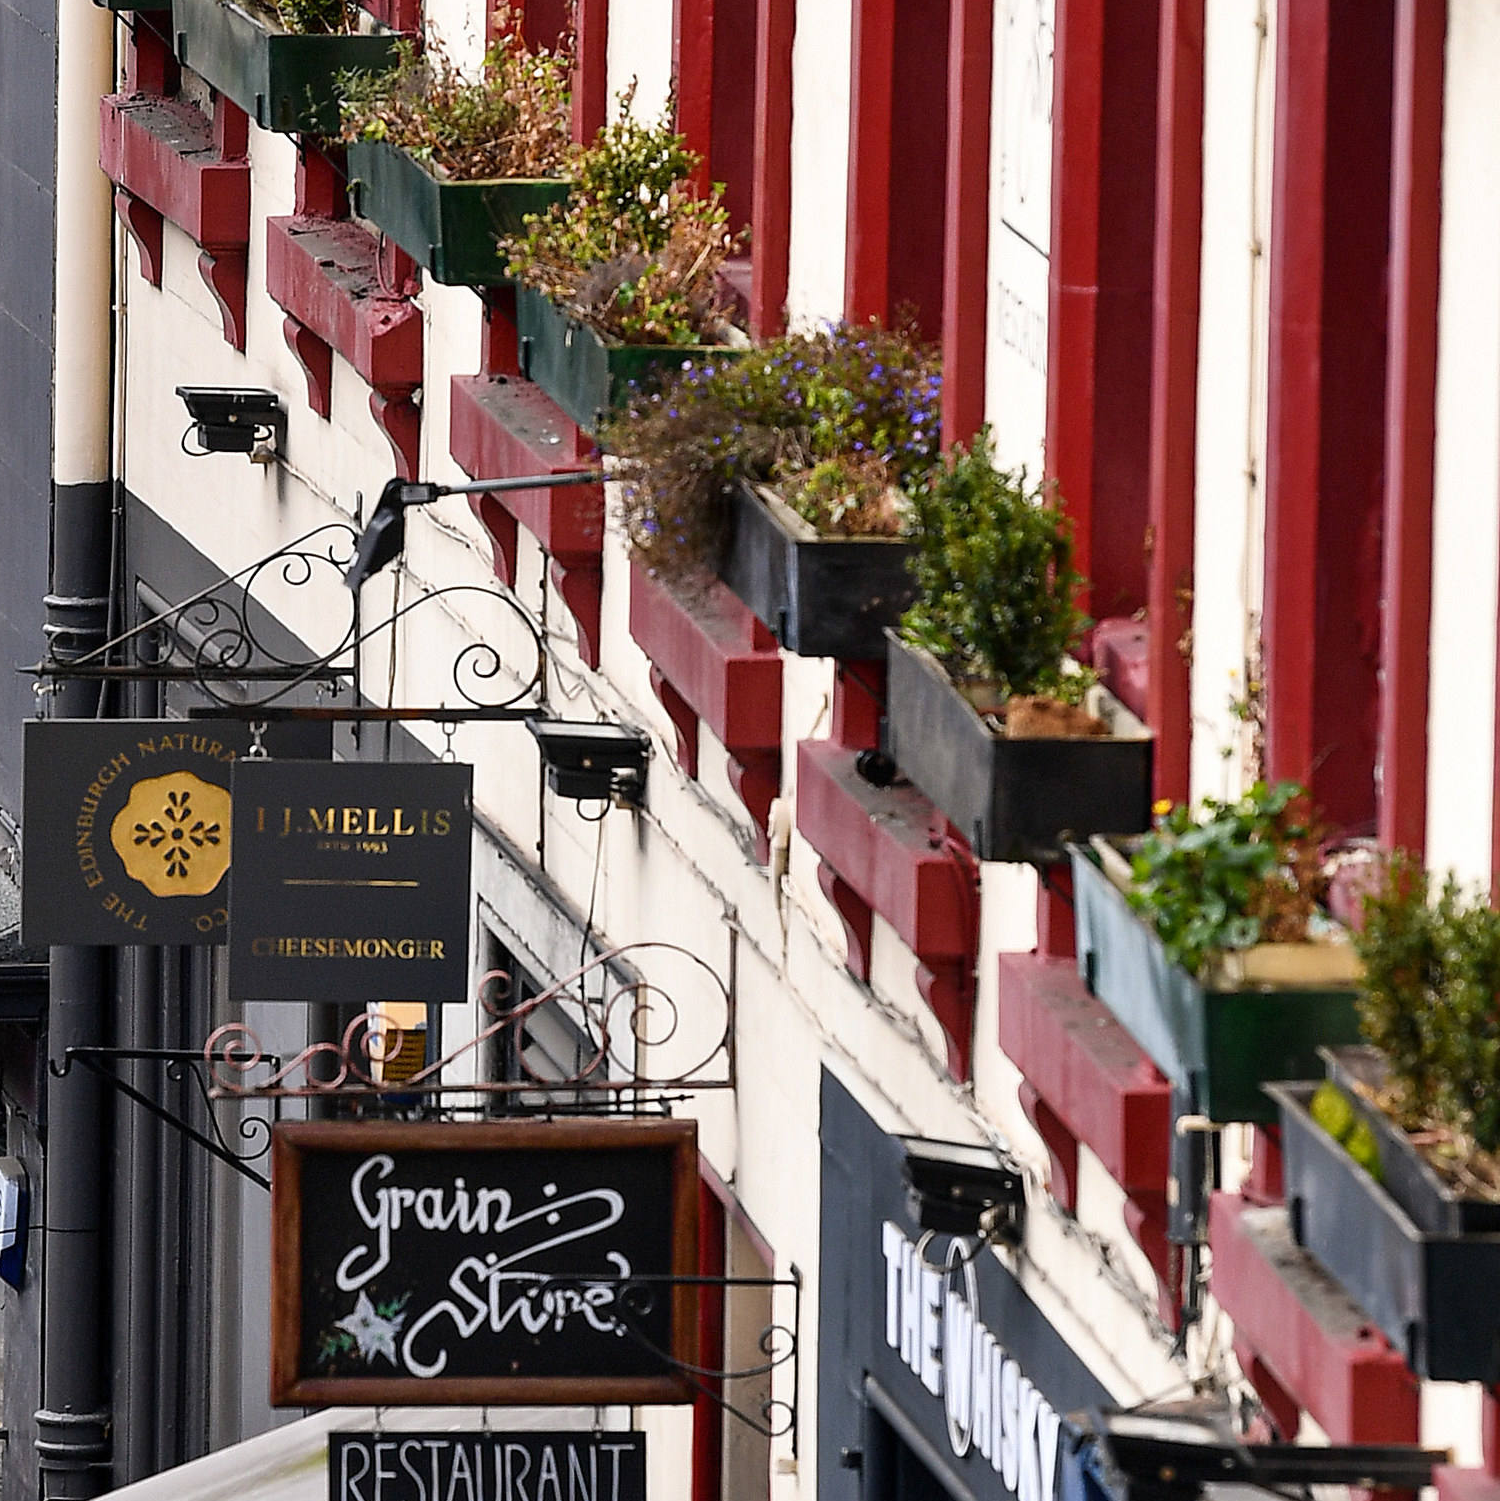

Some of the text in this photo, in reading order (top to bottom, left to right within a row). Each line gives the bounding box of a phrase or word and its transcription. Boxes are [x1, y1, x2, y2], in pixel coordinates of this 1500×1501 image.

[77, 752, 131, 888] EDINBURGH
[102, 893, 147, 931] THE
[253, 937, 446, 960] CHEESEMONGER
[336, 1154, 514, 1291] Grain
[402, 1255, 628, 1378] Store
[882, 1220, 943, 1396] THE
